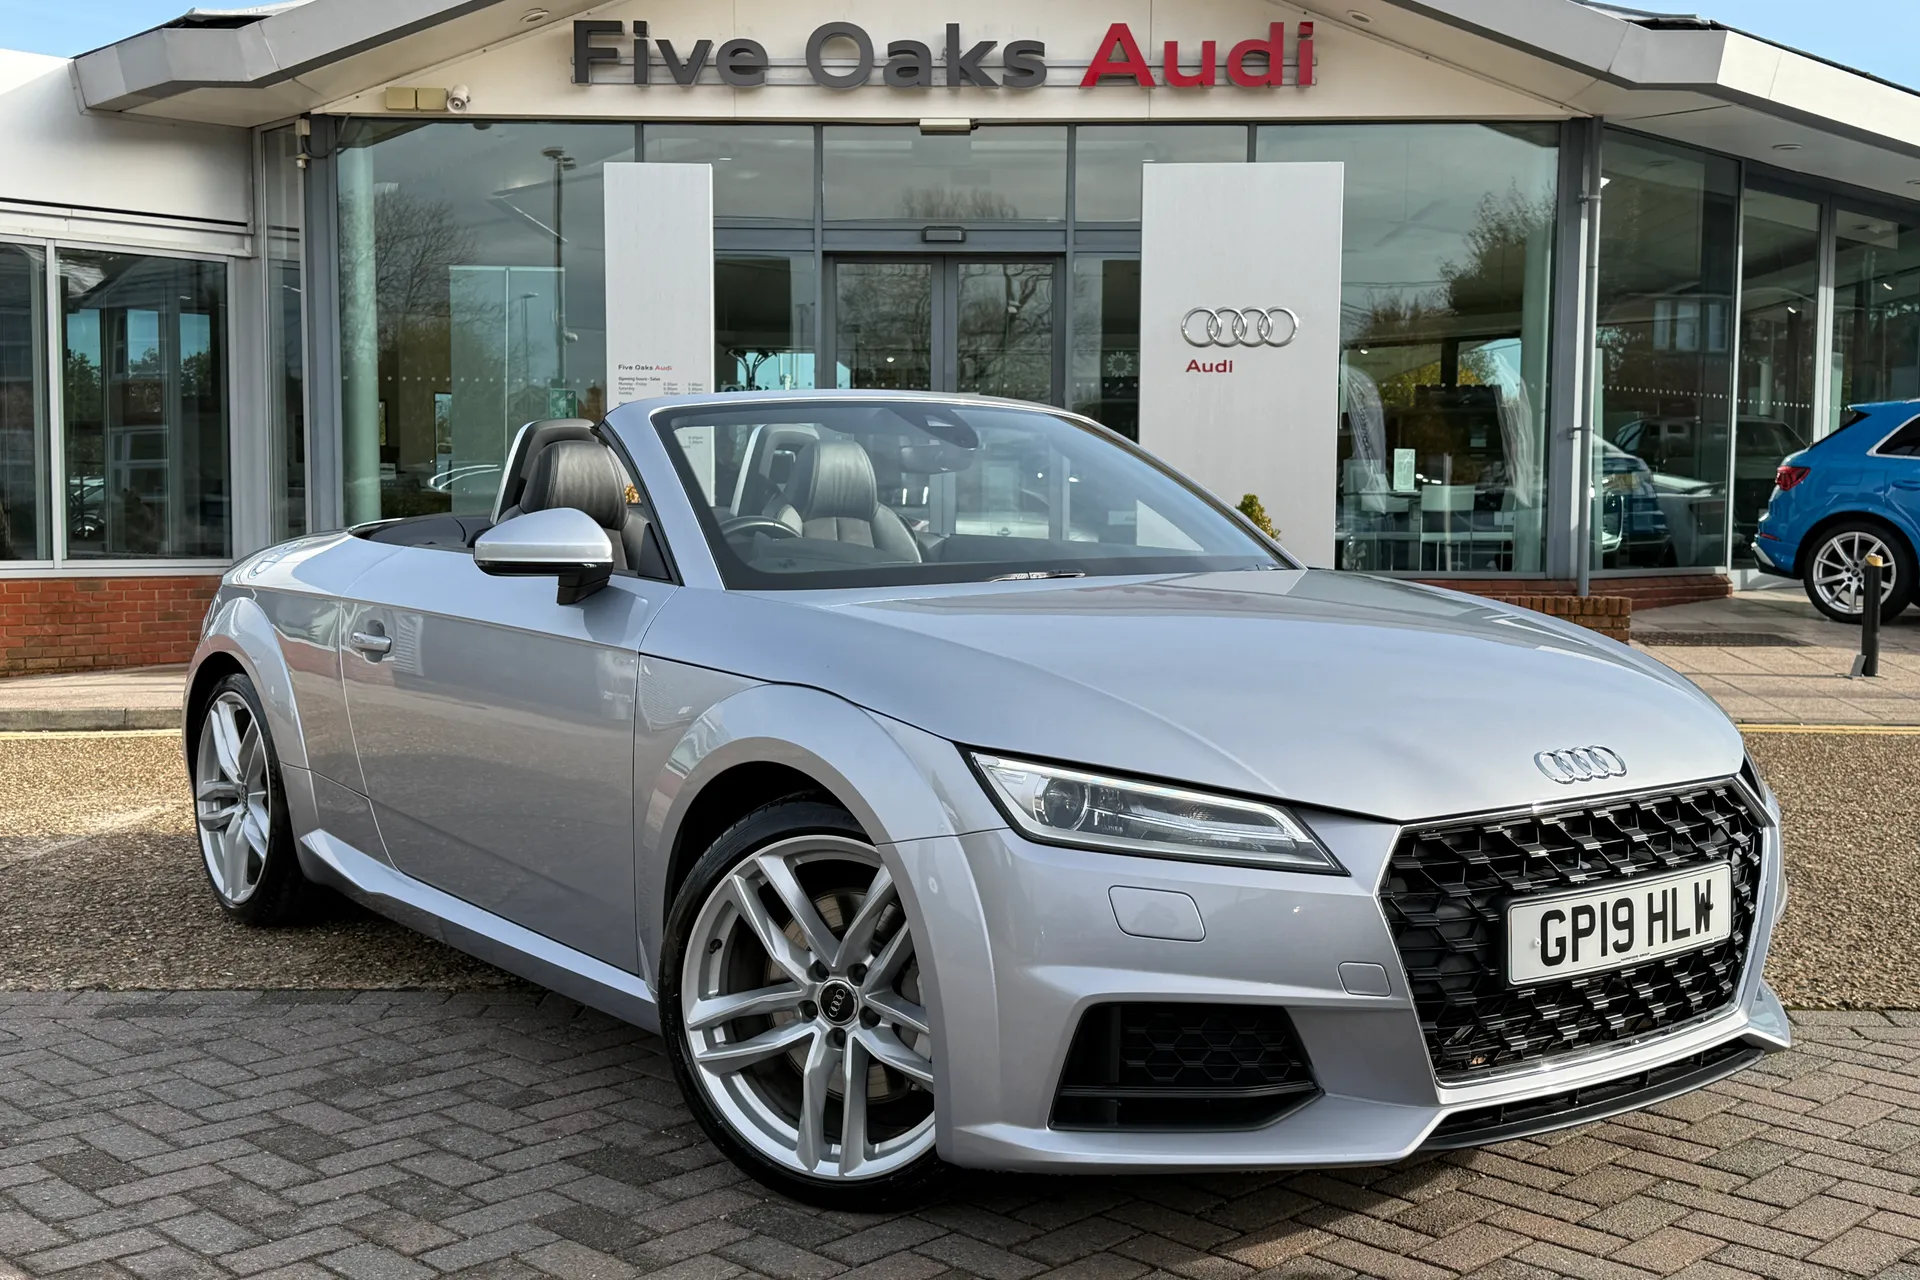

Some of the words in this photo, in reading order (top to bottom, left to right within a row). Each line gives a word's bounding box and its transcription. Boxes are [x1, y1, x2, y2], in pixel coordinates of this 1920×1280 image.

[573, 20, 769, 87] Five
[805, 21, 1047, 88] Oaks
[1079, 21, 1315, 88] Audi
[1185, 359, 1233, 373] Audi
[1540, 897, 1634, 967] GP19
[1647, 879, 1713, 947] HLW
